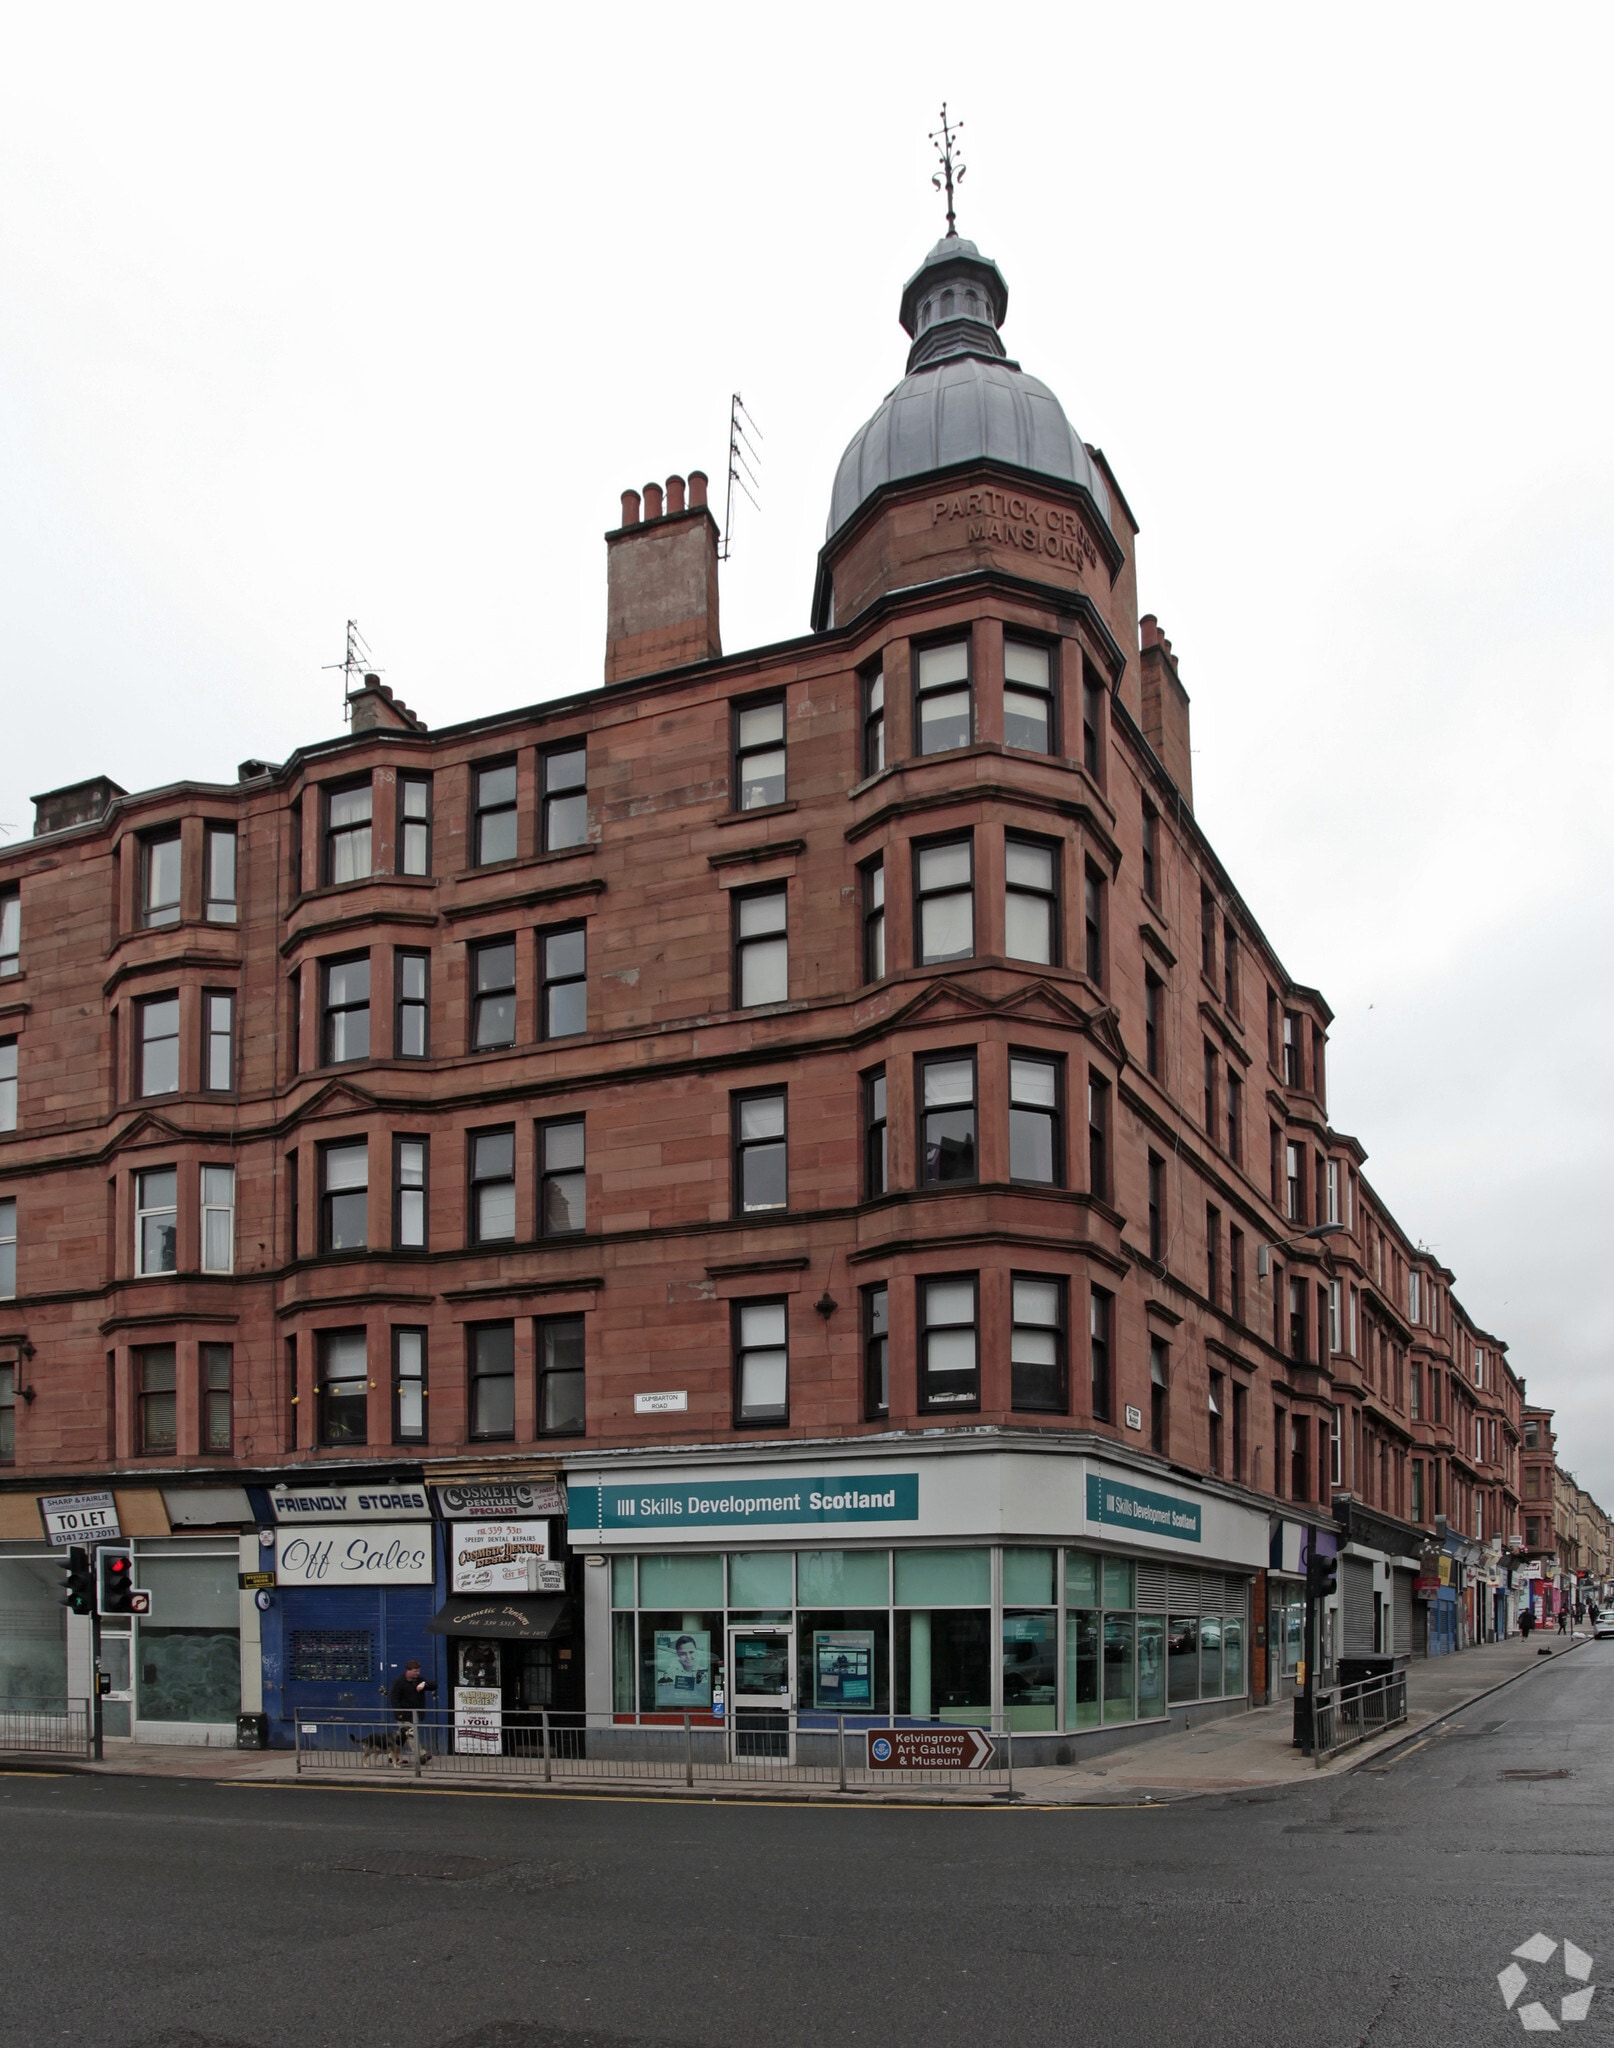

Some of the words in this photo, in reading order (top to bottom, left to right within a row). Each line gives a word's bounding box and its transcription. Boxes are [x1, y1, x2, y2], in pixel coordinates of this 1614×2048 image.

[932, 491, 1039, 525] PARTICK
[1046, 510, 1097, 569] CROSS
[968, 522, 1084, 571] MANSIONS
[47, 1498, 73, 1507] SHARP
[82, 1494, 110, 1503] FAIRLIE
[275, 1495, 347, 1513] FRIENDLY
[358, 1493, 424, 1510] STORES
[446, 1484, 532, 1507] COSMETIC
[465, 1497, 518, 1507] DENTURE
[640, 1498, 683, 1517] Skills
[687, 1493, 801, 1516] Development
[809, 1490, 896, 1511] Scotland
[469, 1506, 518, 1515] SPECIALIST
[1115, 1496, 1132, 1517] Skills
[1133, 1501, 1171, 1525] Development
[1172, 1510, 1196, 1531] Scotland
[57, 1513, 78, 1530] TO
[81, 1511, 106, 1528] LET
[56, 1534, 76, 1542] 0141
[79, 1531, 94, 1541] 221
[96, 1529, 115, 1538] 2011
[488, 1526, 503, 1536] 339
[282, 1538, 333, 1579] Off
[340, 1539, 425, 1570] Sales
[458, 1545, 504, 1566] COSMETIC
[453, 1607, 497, 1623] Cosmetic
[896, 1734, 965, 1744] Kelvingrove
[897, 1745, 916, 1754] Art
[920, 1745, 963, 1756] Gallery
[899, 1757, 908, 1765] &
[912, 1756, 961, 1765] Museum
